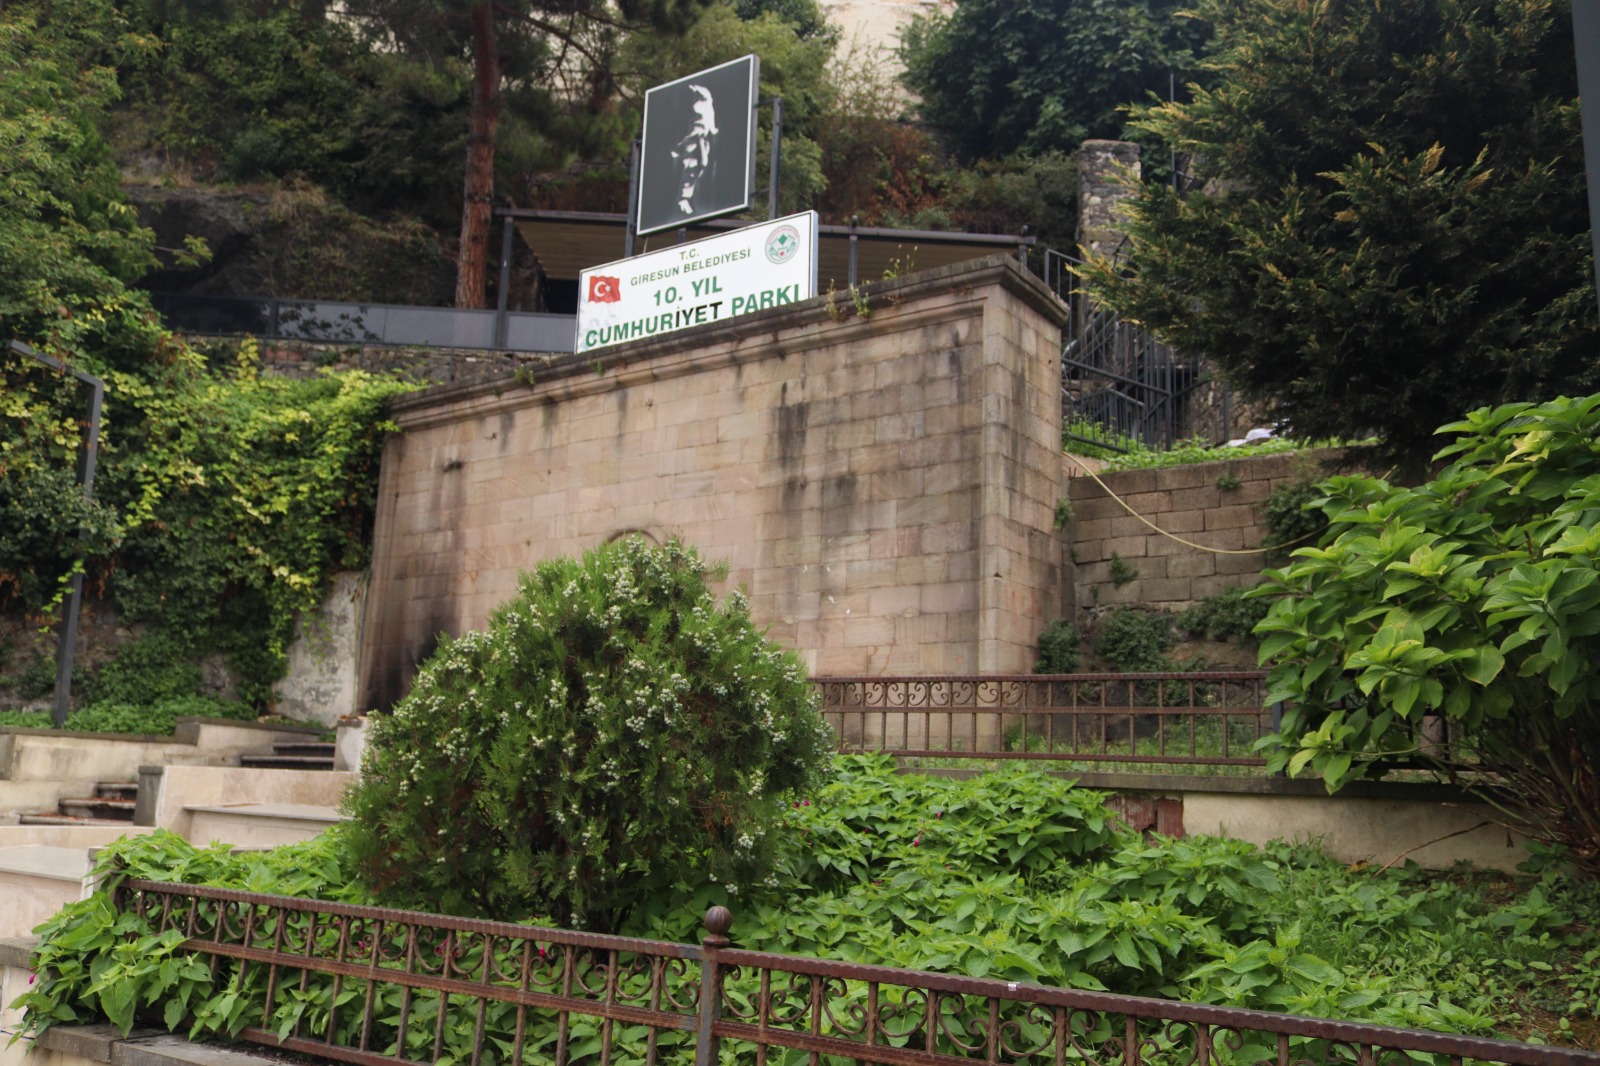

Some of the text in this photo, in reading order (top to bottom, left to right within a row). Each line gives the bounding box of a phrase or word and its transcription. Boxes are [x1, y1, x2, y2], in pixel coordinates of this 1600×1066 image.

[631, 246, 751, 286] GİRESUN BELEDİYESİ
[680, 249, 700, 260] T.C.
[653, 276, 723, 306] 10. YIL
[585, 284, 799, 347] CUMHURİYET PARKI
